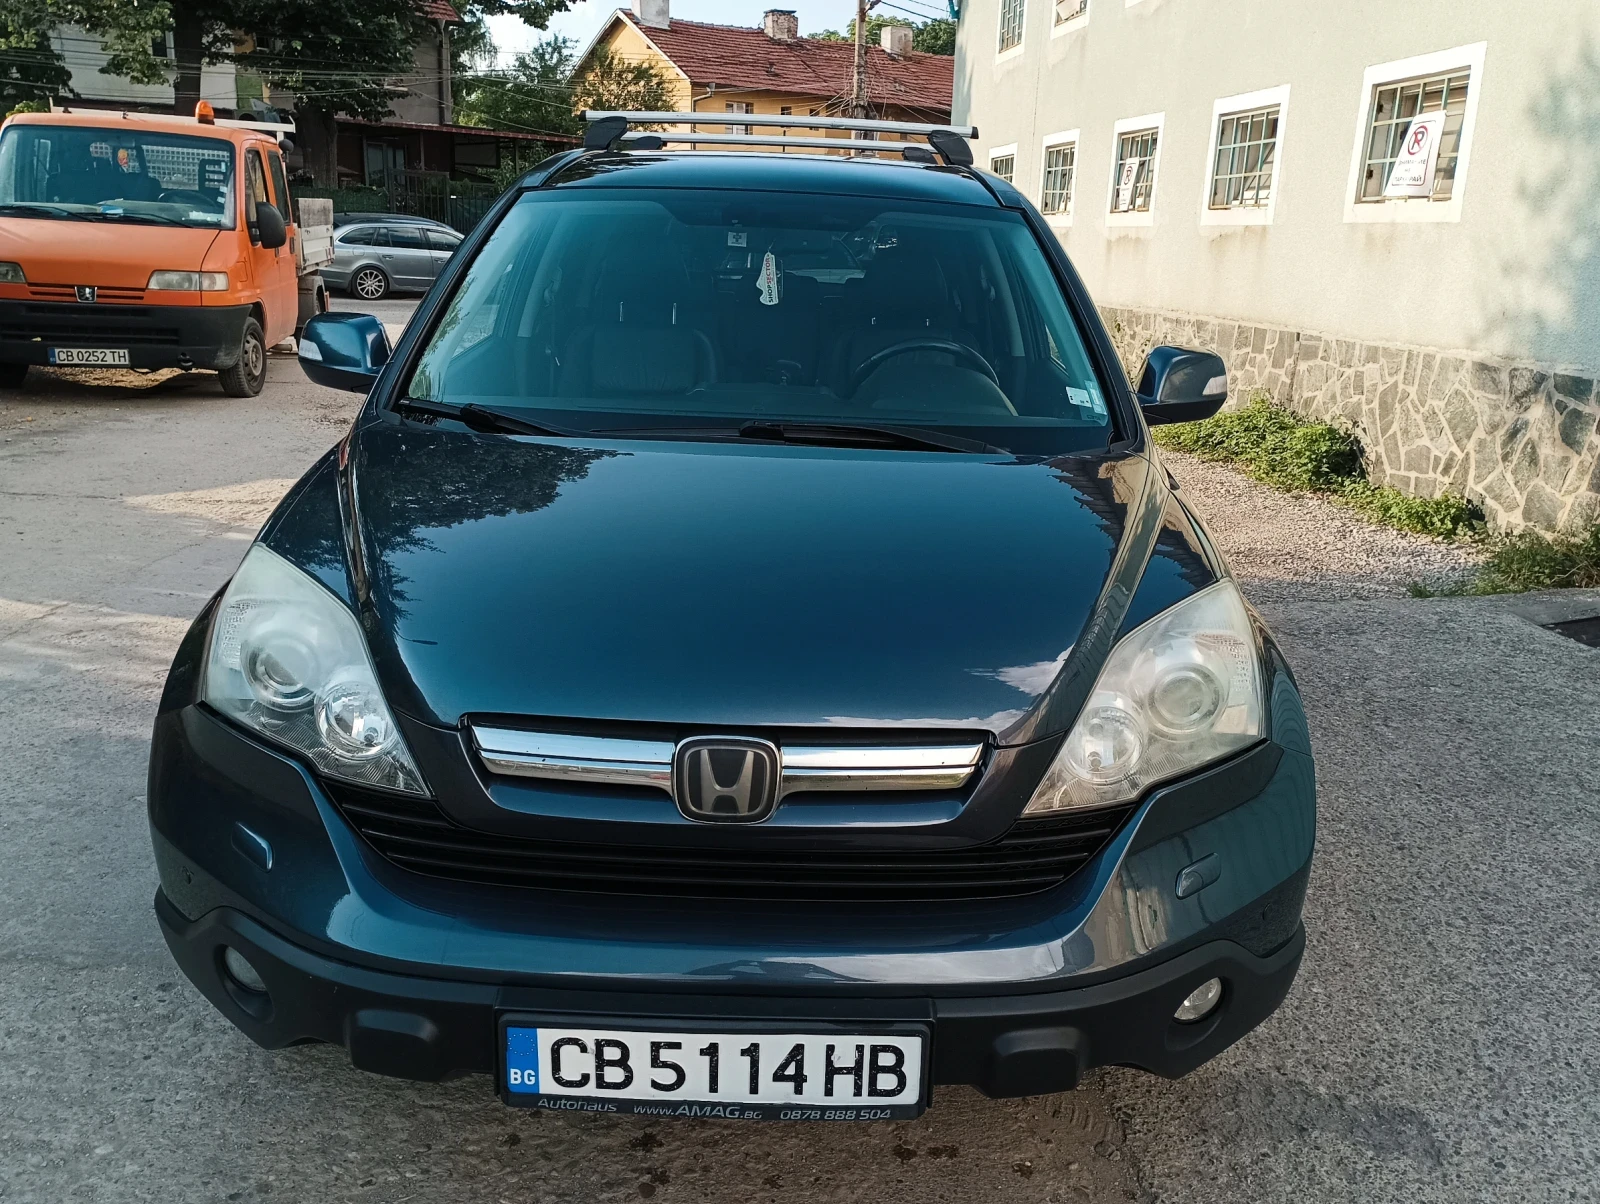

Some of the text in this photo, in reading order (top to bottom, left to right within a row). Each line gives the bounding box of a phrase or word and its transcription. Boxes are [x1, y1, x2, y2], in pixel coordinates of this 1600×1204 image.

[765, 257, 774, 303] SHOPSECTOR
[57, 350, 75, 362] CB
[76, 350, 108, 362] 0252
[109, 351, 127, 362] TH
[510, 1068, 536, 1085] BG
[550, 1037, 907, 1098] CB 5114 HB
[538, 1097, 618, 1112] Autohaus
[780, 1109, 821, 1120] 0878
[824, 1109, 857, 1120] 888
[859, 1109, 892, 1120] 504
